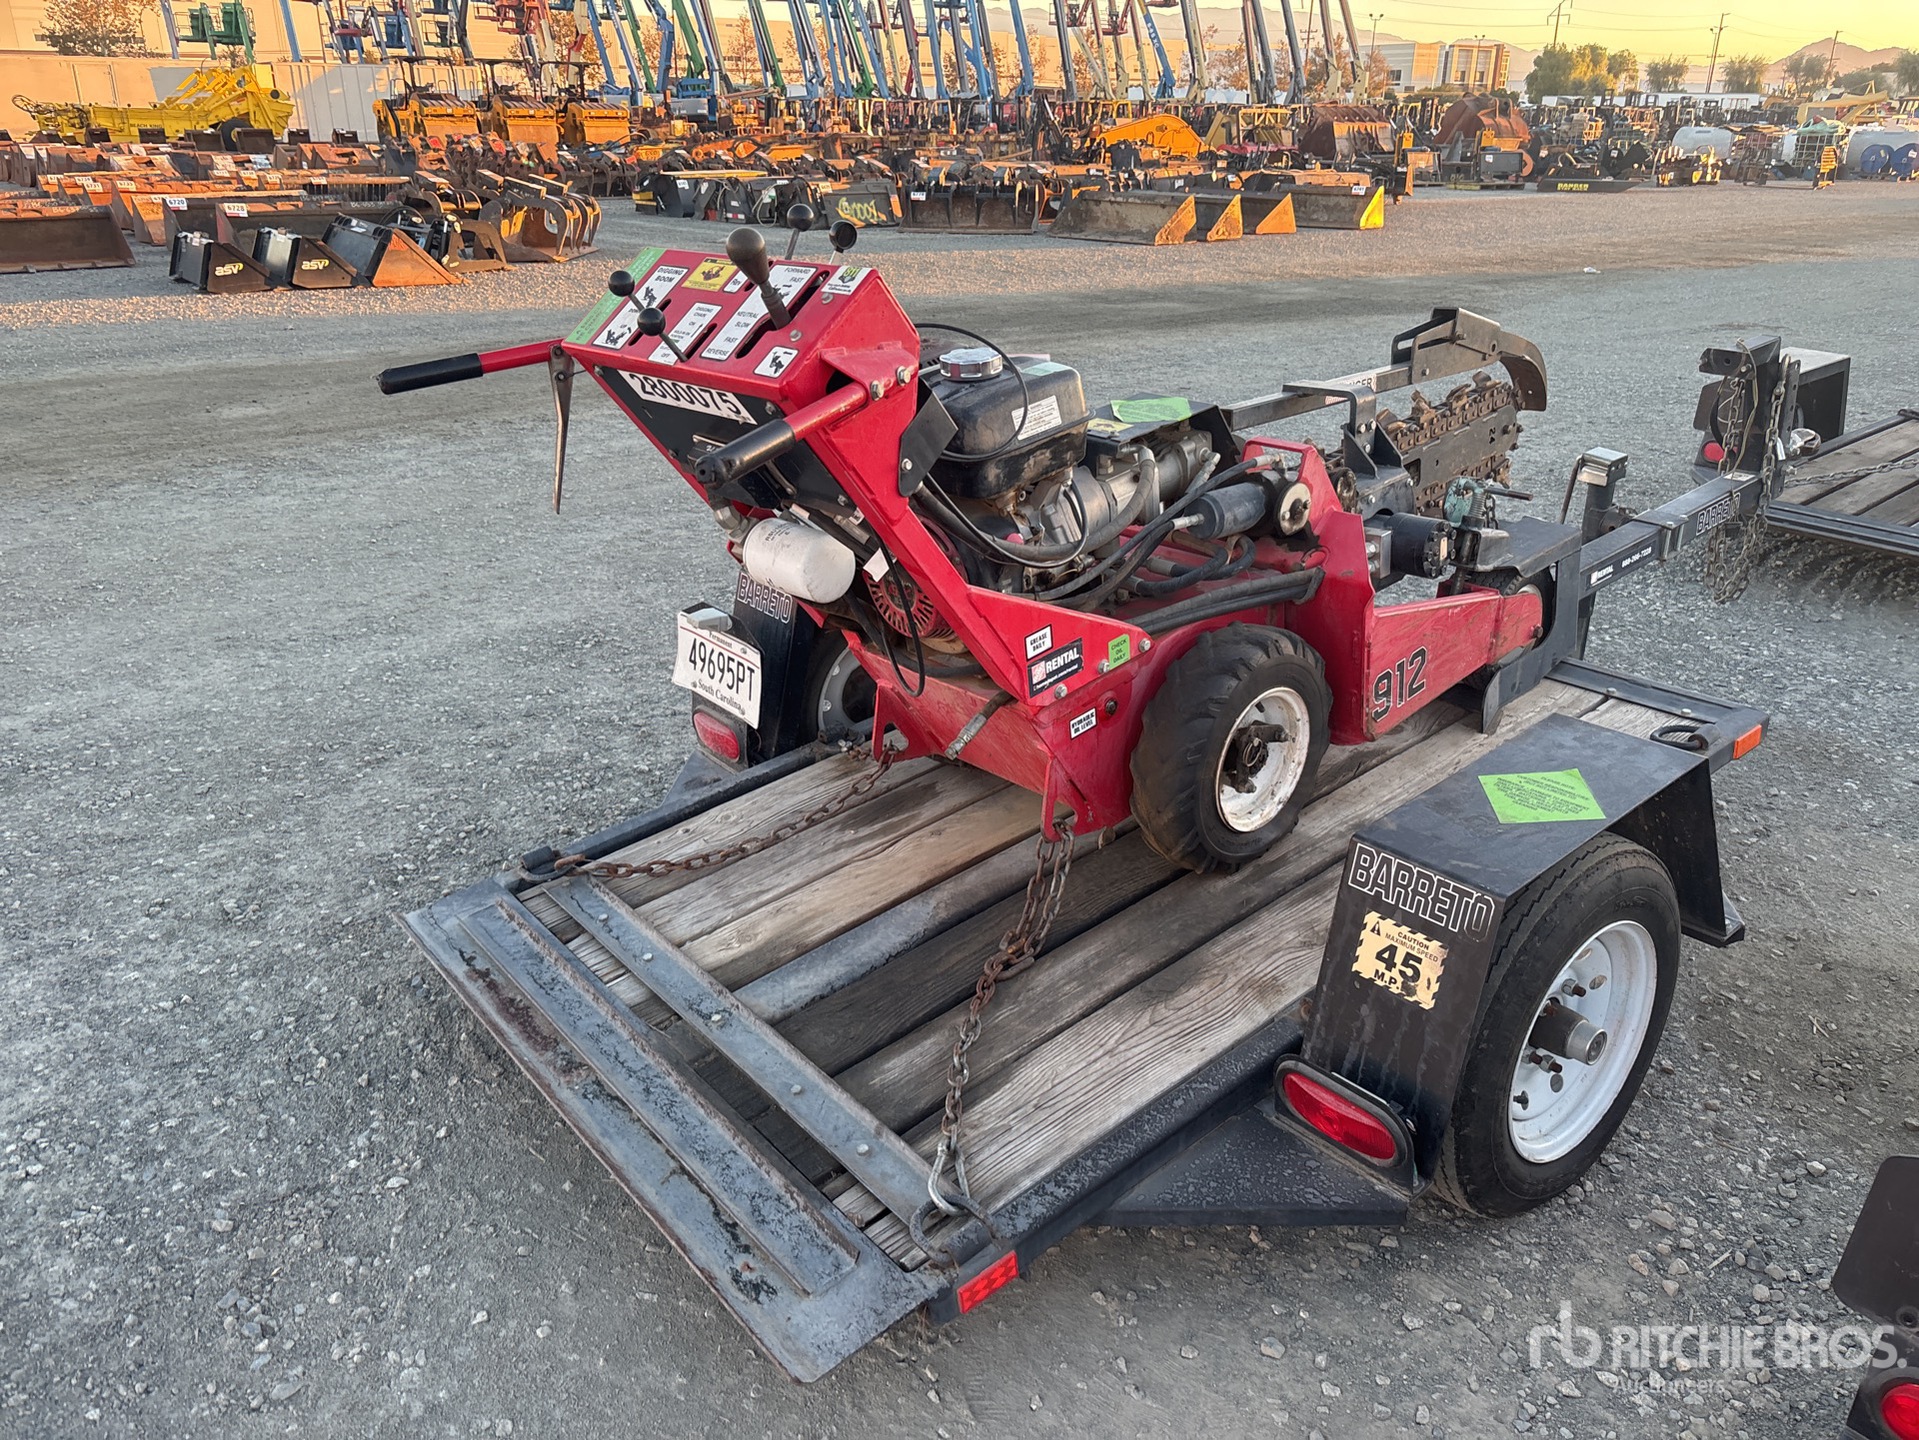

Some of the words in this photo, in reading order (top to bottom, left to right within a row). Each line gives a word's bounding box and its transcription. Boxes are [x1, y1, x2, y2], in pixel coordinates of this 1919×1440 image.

[654, 275, 675, 283] BOOM
[657, 267, 684, 276] DIGGING
[784, 267, 811, 275] FORWARD
[842, 267, 861, 276] 811
[737, 311, 759, 319] NEUTRAL
[705, 347, 731, 356] REVERSE
[629, 373, 742, 415] 2800075
[737, 572, 794, 624] BARRETO
[1029, 632, 1048, 646] GREASE
[1032, 640, 1046, 652] DAILY
[1111, 638, 1127, 651] CHECK
[1045, 647, 1080, 674] RENTAL
[1113, 653, 1126, 663] DAILY
[688, 637, 756, 702] 49695PT
[1371, 646, 1428, 722] 912
[698, 678, 715, 697] South
[715, 689, 742, 711] Carolina
[1348, 842, 1496, 943] BARRETO
[1384, 932, 1416, 952] MAXIMUM
[1415, 946, 1439, 963] SPEED
[1396, 931, 1430, 951] CAUTION
[1375, 943, 1423, 984] 45
